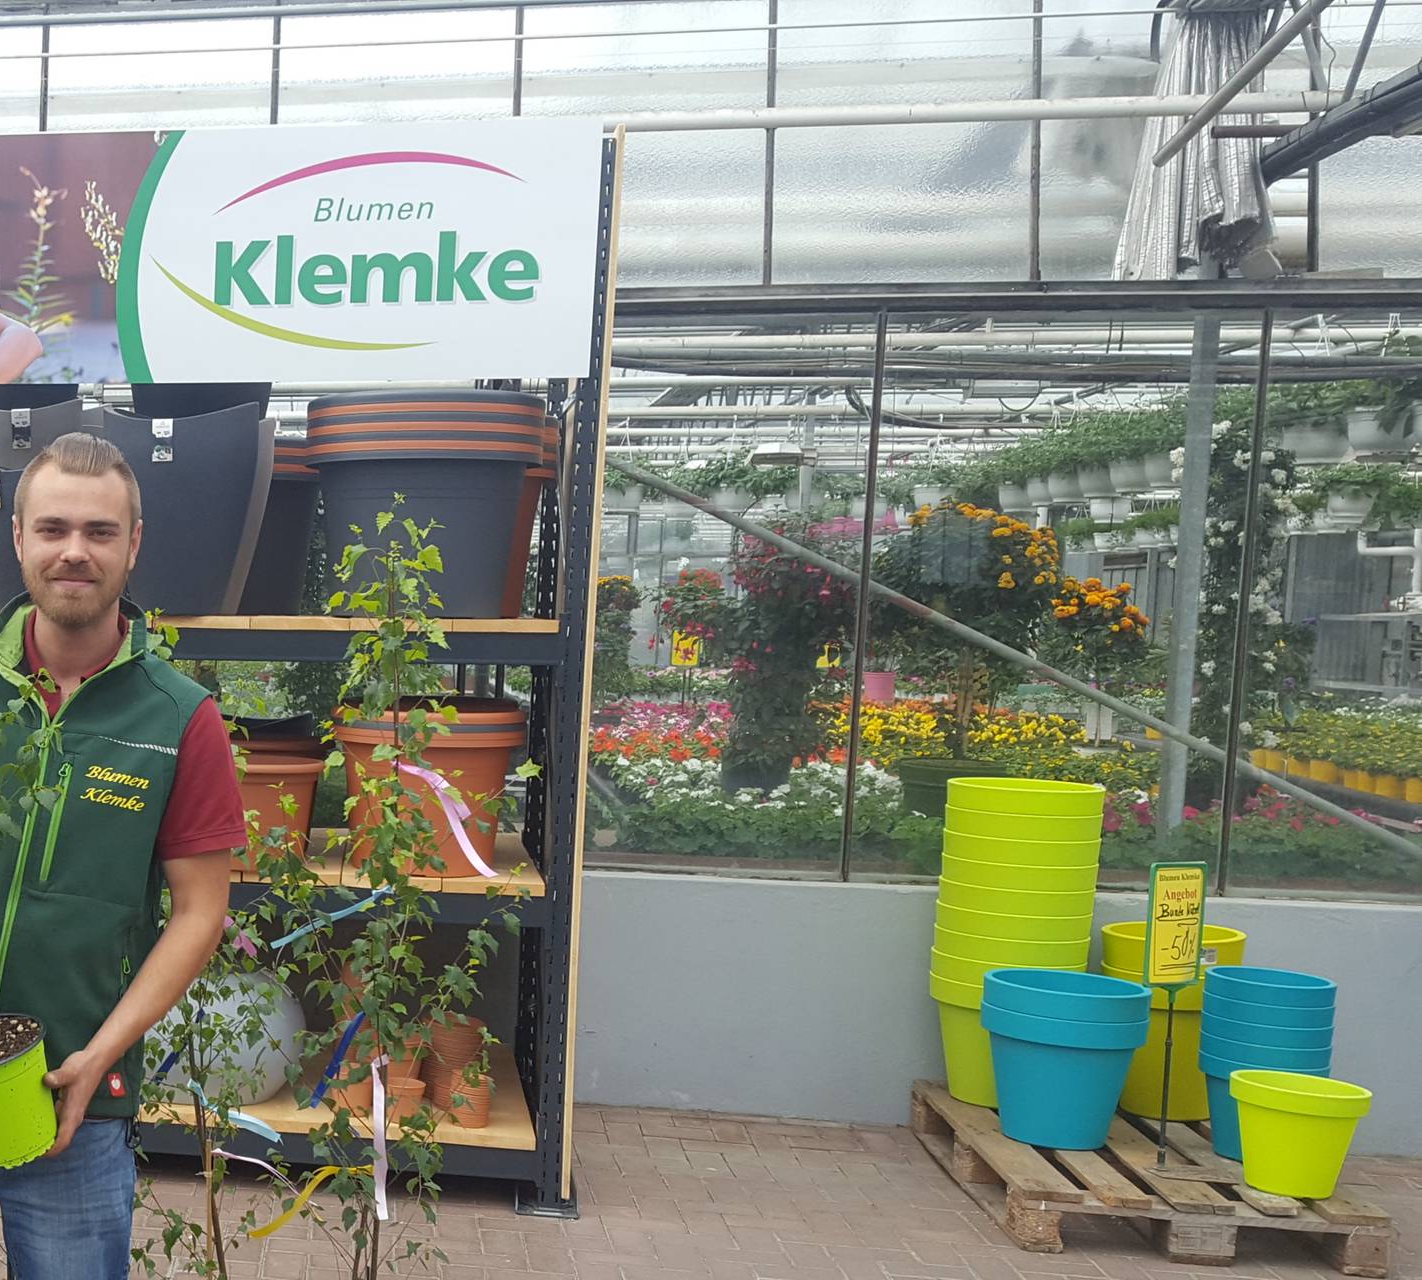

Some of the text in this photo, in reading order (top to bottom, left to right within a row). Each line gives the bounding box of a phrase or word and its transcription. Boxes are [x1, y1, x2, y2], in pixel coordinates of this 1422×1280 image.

[313, 197, 435, 223] Blumen
[213, 230, 541, 307] Klemke
[85, 765, 150, 790] Blumen
[80, 787, 145, 812] Klemke
[1163, 887, 1197, 902] Angebot
